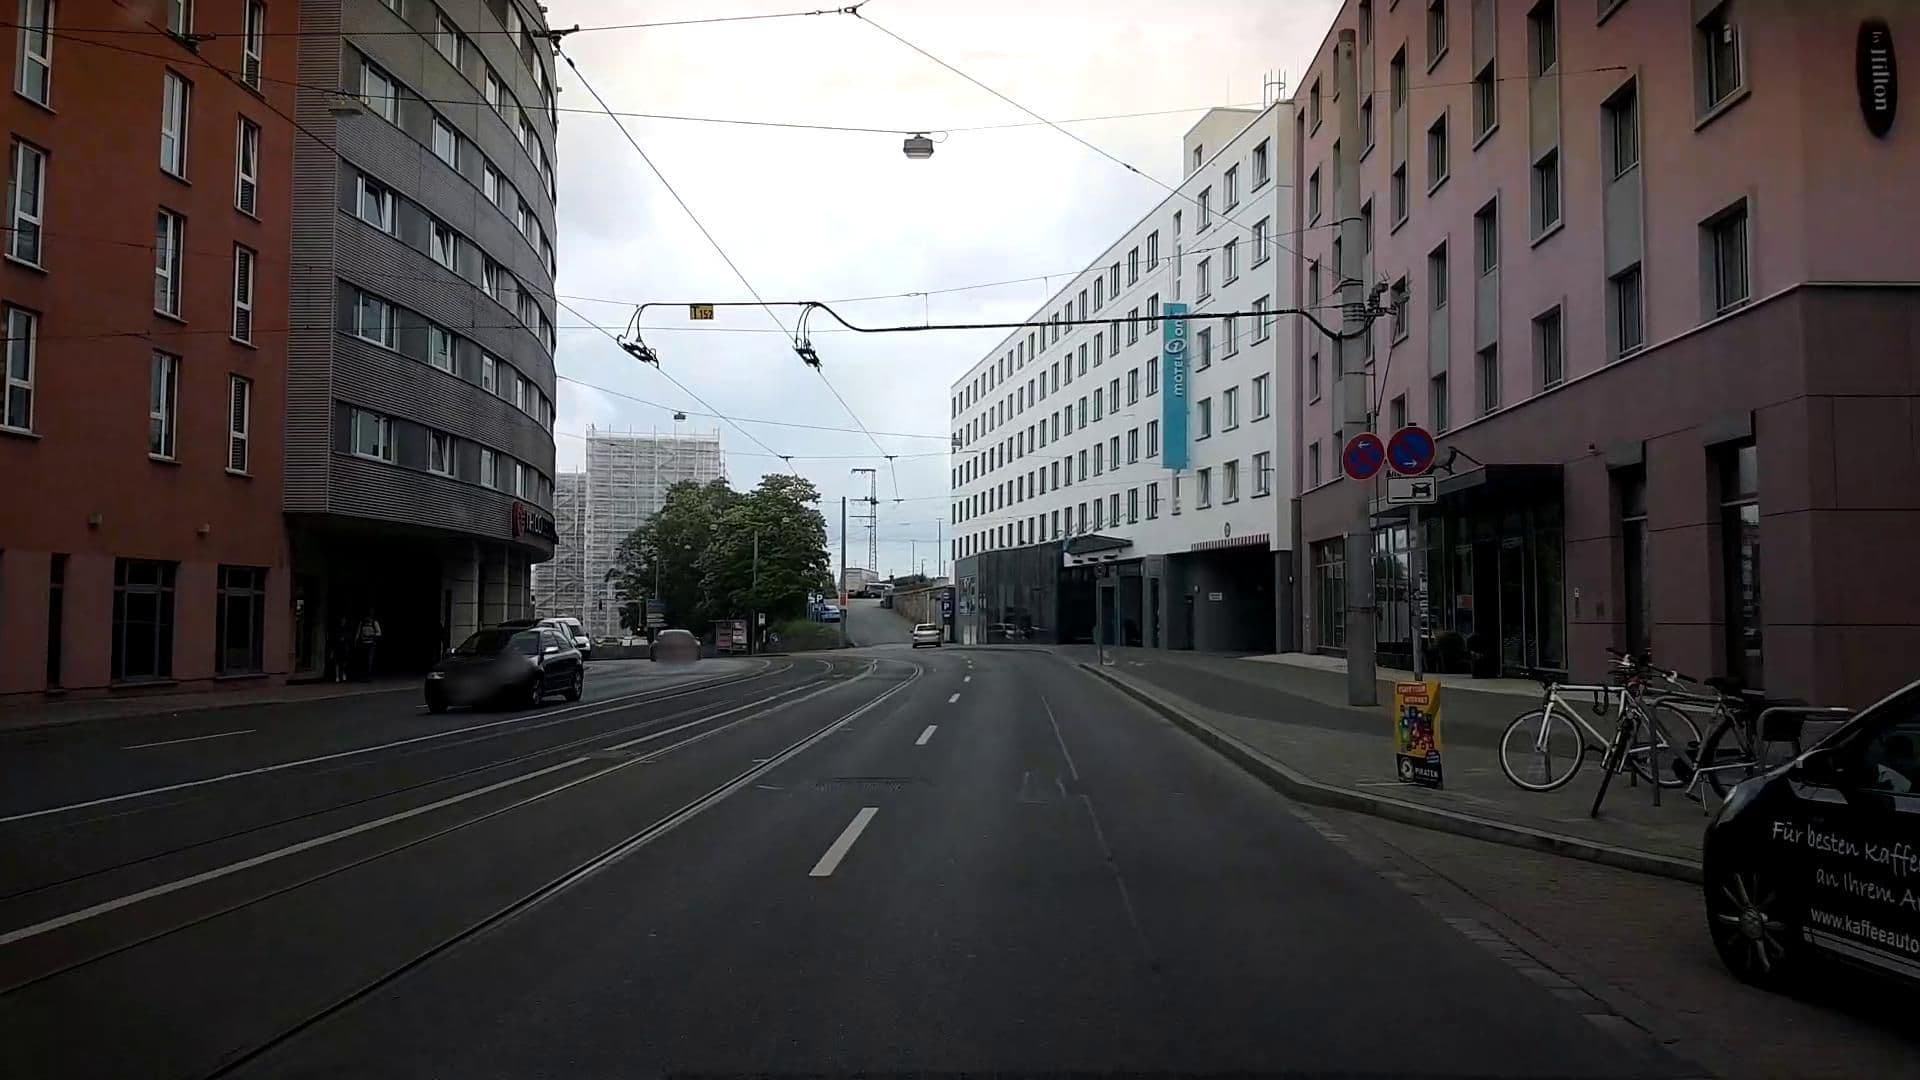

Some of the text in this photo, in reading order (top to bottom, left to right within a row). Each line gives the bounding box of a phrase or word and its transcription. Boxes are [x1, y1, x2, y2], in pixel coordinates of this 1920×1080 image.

[1870, 49, 1890, 110] Hilton
[1772, 820, 1920, 877] Für besten Kaffe
[1816, 868, 1839, 887] an
[1844, 872, 1896, 903] Ihrem
[1810, 907, 1920, 953] www.kaffeeauto
